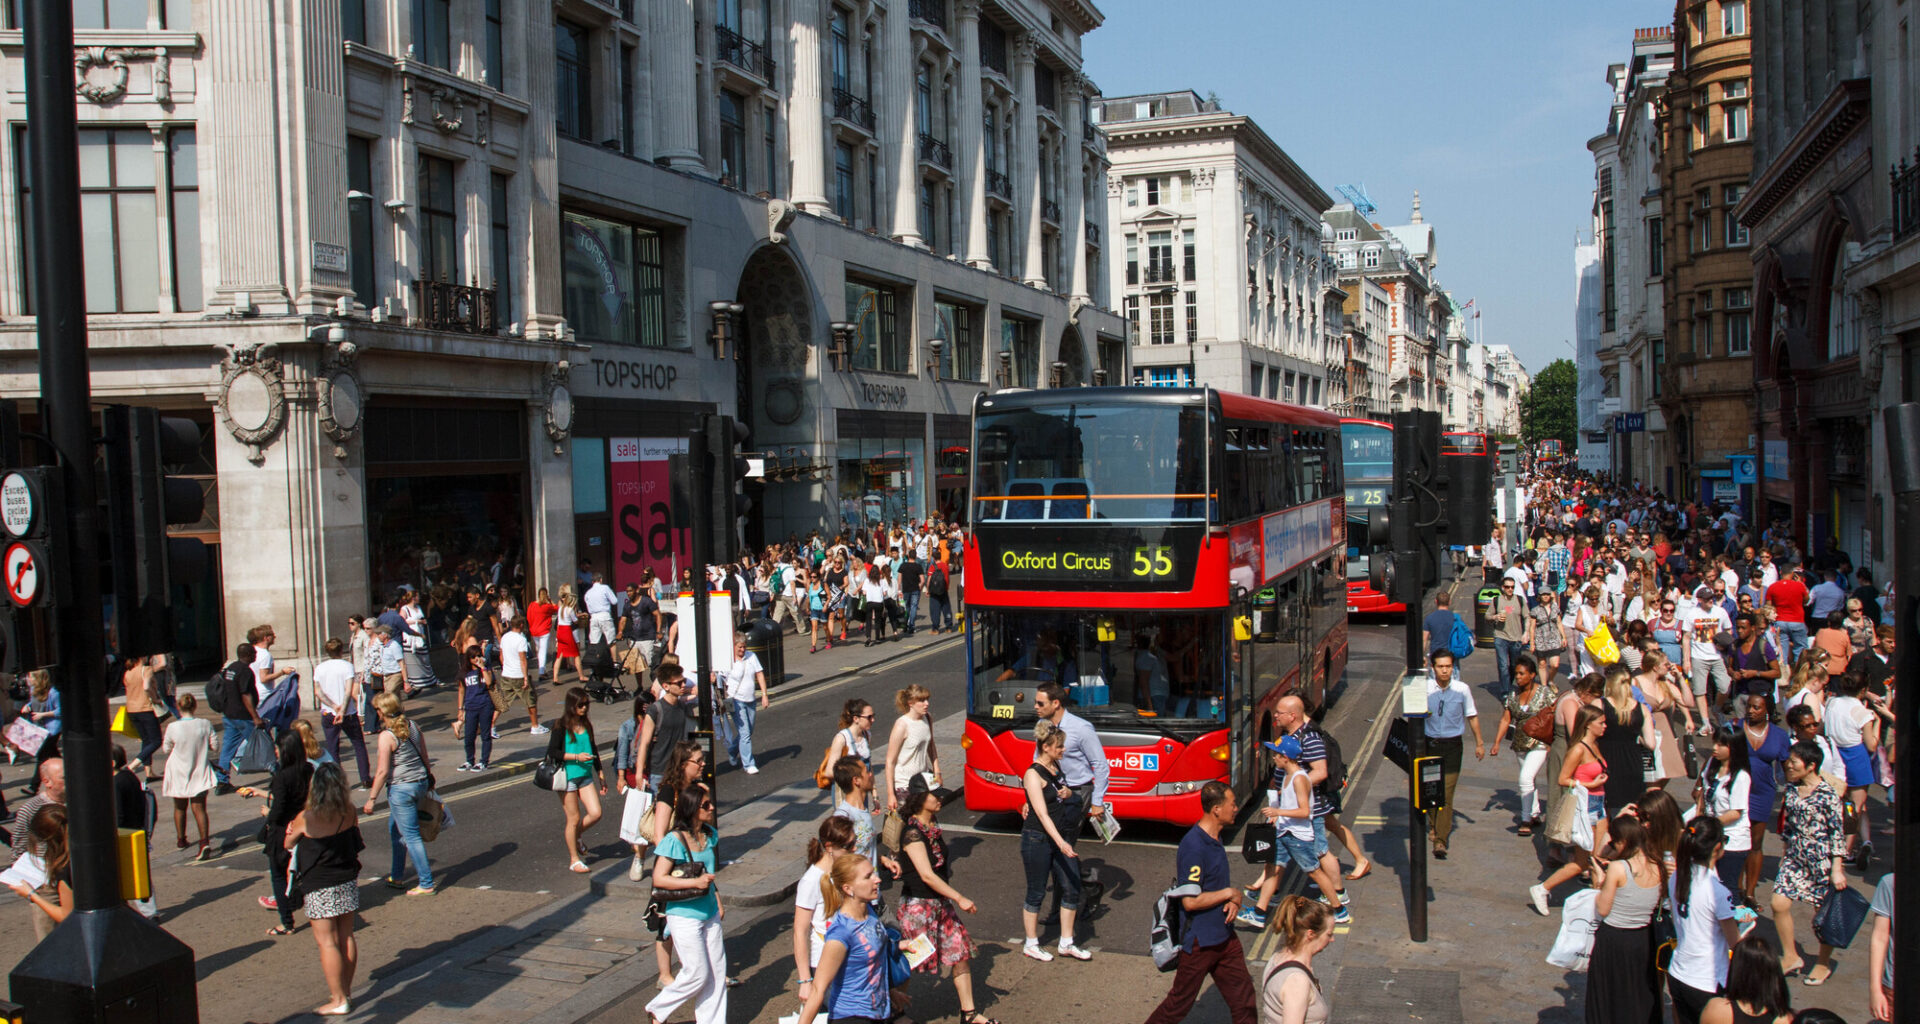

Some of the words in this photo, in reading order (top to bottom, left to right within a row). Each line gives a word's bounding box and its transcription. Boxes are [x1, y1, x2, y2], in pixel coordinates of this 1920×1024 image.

[580, 232, 616, 295] TOPSHOP
[591, 358, 677, 391] TOPSHOP
[861, 382, 906, 405] TOPSHOP
[616, 440, 637, 457] sale
[4, 485, 28, 495] Except
[616, 481, 656, 496] TOPSHOP
[1363, 490, 1382, 504] 25
[7, 506, 28, 518] cycles
[1002, 551, 1056, 569] Oxford
[1062, 552, 1112, 570] Circus
[1132, 546, 1173, 576] 55
[1188, 865, 1201, 882] 2
